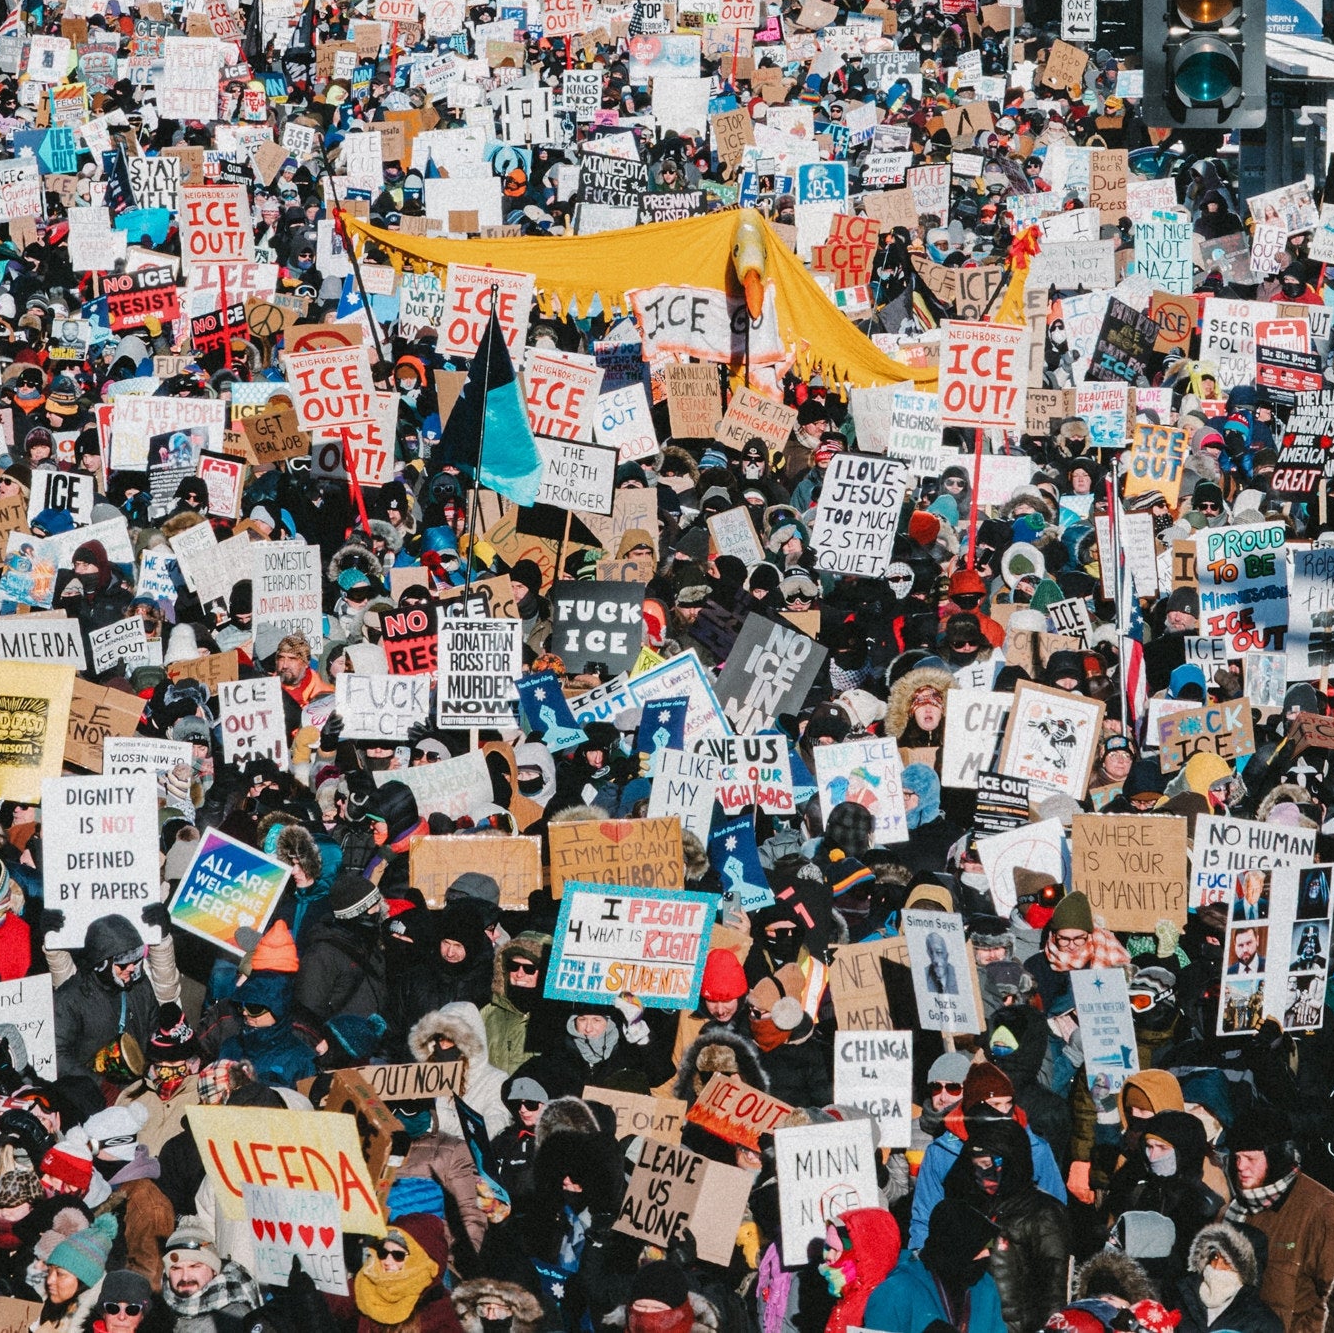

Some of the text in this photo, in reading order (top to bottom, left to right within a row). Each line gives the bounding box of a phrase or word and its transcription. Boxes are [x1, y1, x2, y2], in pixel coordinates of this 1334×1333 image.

[379, 3, 415, 19] OUT!
[721, 6, 756, 24] OUT!
[1068, 1, 1091, 11] ONE
[1068, 13, 1092, 22] WAY
[566, 74, 599, 85] NO
[566, 85, 602, 97] KINGS
[131, 158, 179, 179] STAY
[184, 191, 239, 199] NEIGHBORS SAY
[188, 201, 240, 227] ICE
[1136, 223, 1191, 242] MN NICE
[190, 232, 246, 256] OUT!
[1146, 242, 1182, 262] NOT
[1138, 261, 1187, 282] NAZI
[948, 330, 1020, 344] NEIGHBORS SAY
[947, 344, 1013, 382] ICE
[943, 381, 1019, 419] OUT!
[562, 446, 585, 461] THE
[550, 460, 597, 481] NORTH
[835, 460, 843, 480] I
[565, 479, 575, 488] IS
[535, 485, 605, 509] STRONGER
[832, 484, 896, 507] JESUS
[824, 505, 896, 531] TOO MUCH
[820, 529, 889, 551] 2 STAY
[558, 599, 642, 625] FUCK
[441, 621, 518, 632] ARREST
[2, 631, 80, 659] MIERDA
[446, 633, 515, 652] JONATHAN
[564, 629, 629, 655] ICE
[449, 652, 510, 672] ROSS FOR
[446, 675, 515, 700] MURDER
[441, 700, 520, 714] NOW!
[11, 714, 45, 730] FAST
[66, 786, 135, 806] DIGNITY
[80, 813, 135, 835] IS NOT
[1082, 825, 1154, 848] WHERE
[66, 850, 135, 871] DEFINED
[1082, 851, 1164, 875] IS YOUR
[201, 854, 273, 899] ALL ARE
[59, 881, 149, 901] BY PAPERS
[194, 870, 266, 913] WELCOME
[184, 888, 239, 925] HERE
[601, 898, 702, 927] I FIGHT
[569, 917, 700, 962] 4 WHAT IS RIGHT
[606, 962, 691, 995] STUDENTS
[638, 1138, 704, 1185] LEAVE
[648, 1177, 671, 1203] US
[618, 1200, 690, 1242] ALONE
